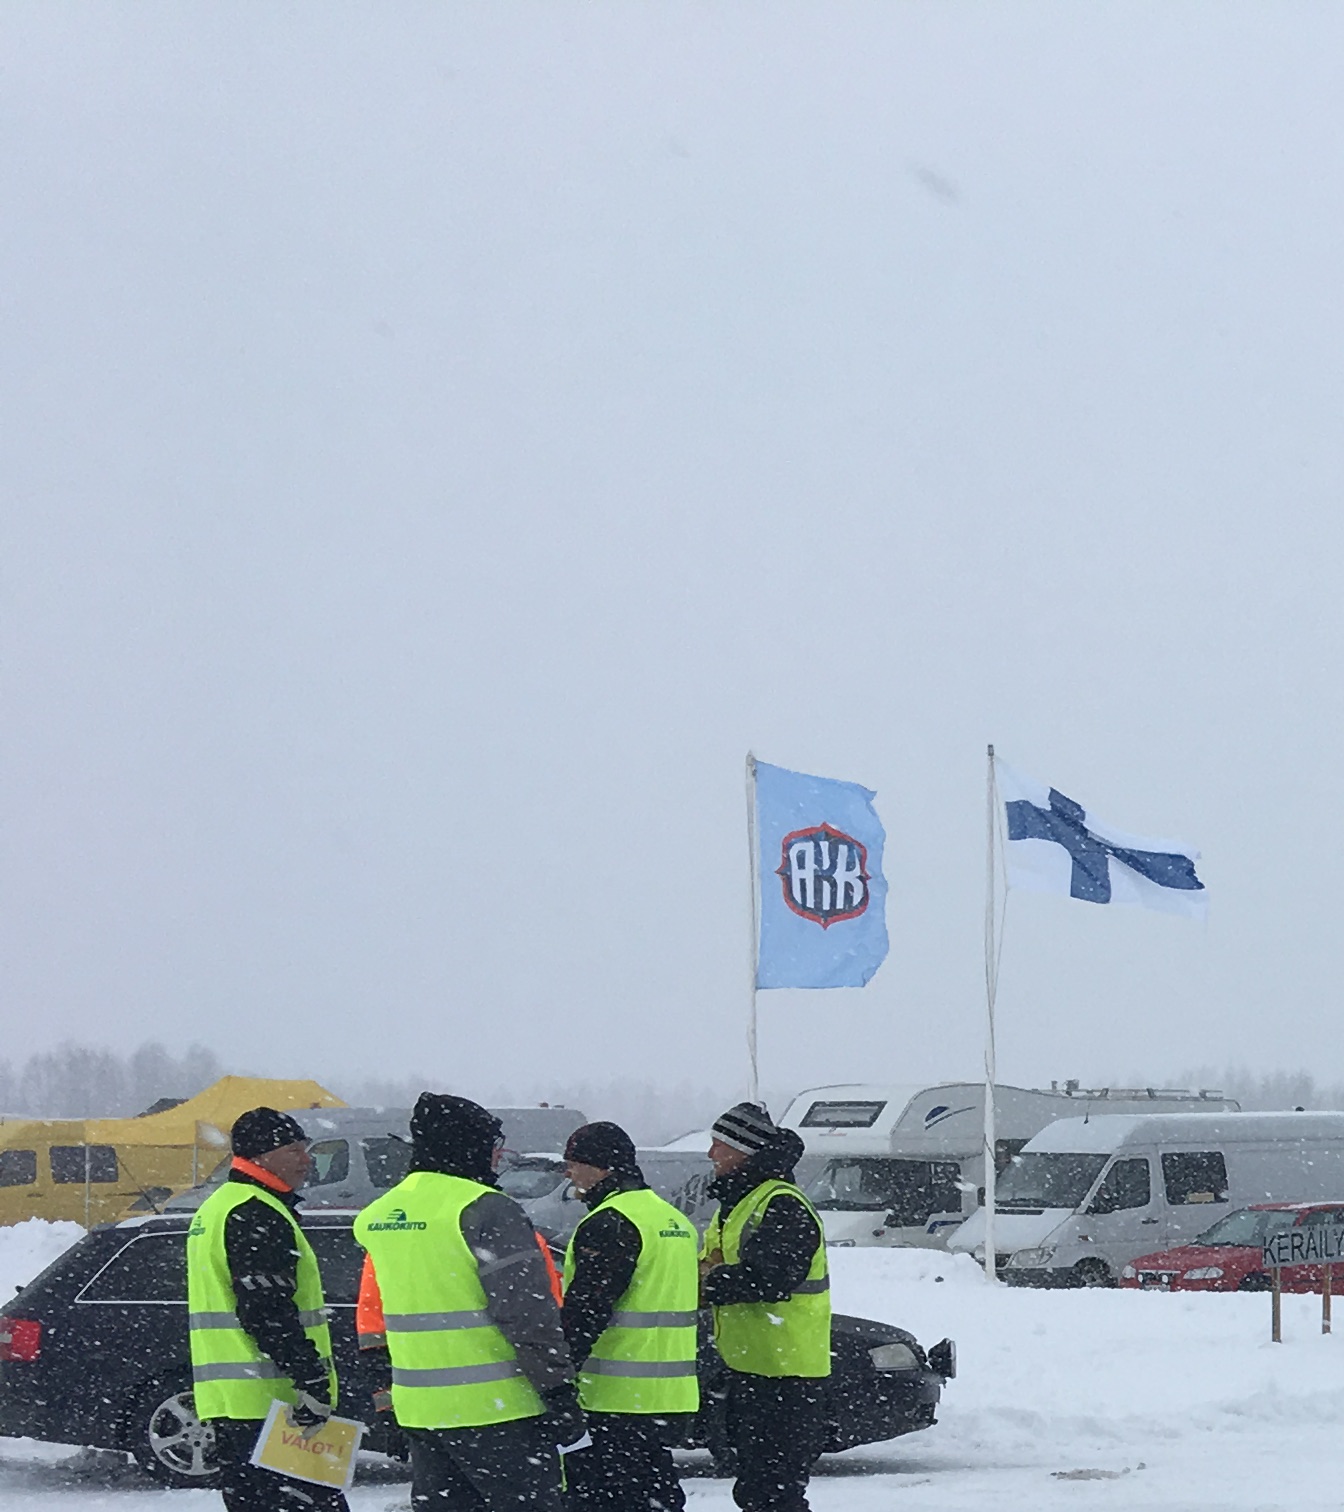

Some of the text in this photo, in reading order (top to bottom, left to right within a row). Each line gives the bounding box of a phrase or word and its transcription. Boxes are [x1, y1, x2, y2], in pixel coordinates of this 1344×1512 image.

[788, 840, 864, 911] AKK
[367, 1221, 427, 1231] KAUKOKIITO
[281, 1430, 335, 1455] VALOT
